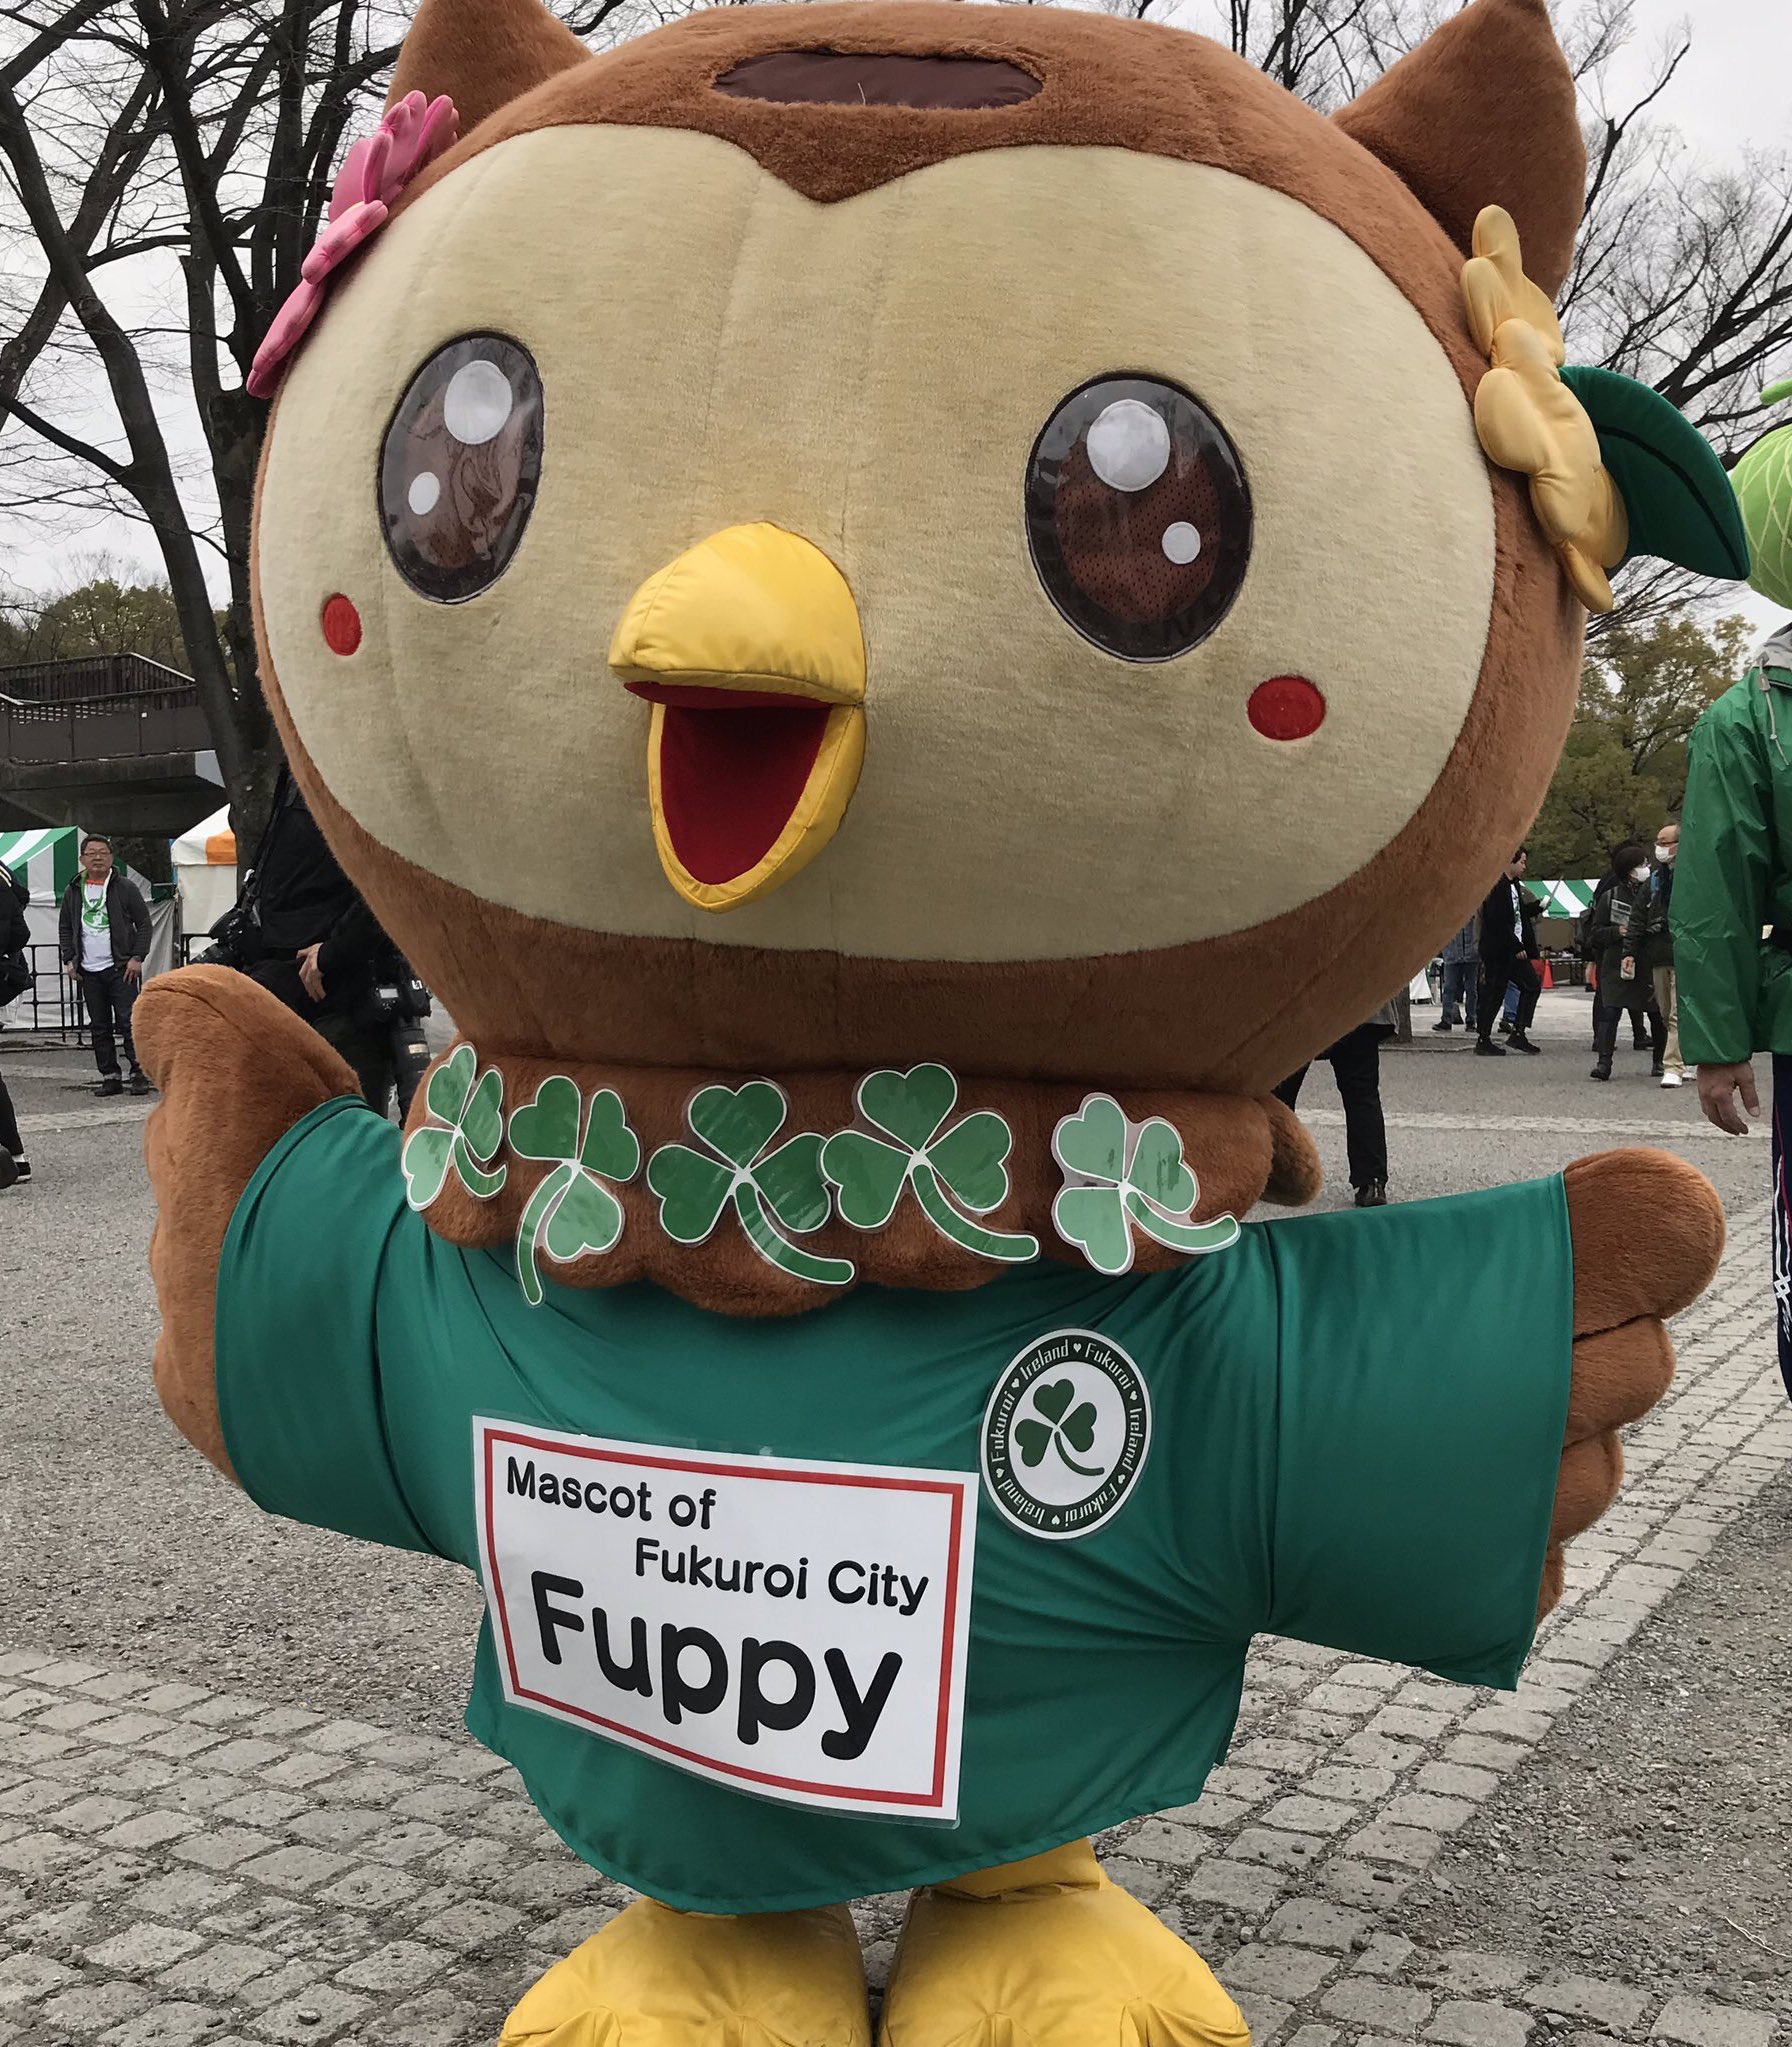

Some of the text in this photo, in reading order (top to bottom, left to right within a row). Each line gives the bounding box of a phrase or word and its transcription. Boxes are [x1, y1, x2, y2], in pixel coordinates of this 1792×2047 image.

[1019, 1339, 1069, 1380] Ireland
[1084, 1342, 1135, 1390] Fukuroi
[990, 1390, 1015, 1463] Fukuroi
[1121, 1407, 1144, 1471] Ireland
[506, 1456, 717, 1529] Mascot of
[998, 1478, 1046, 1525] Ireland
[1064, 1483, 1119, 1526] Fukuroi
[635, 1537, 929, 1616] Fukuroi City
[530, 1570, 903, 1760] Fuppy
